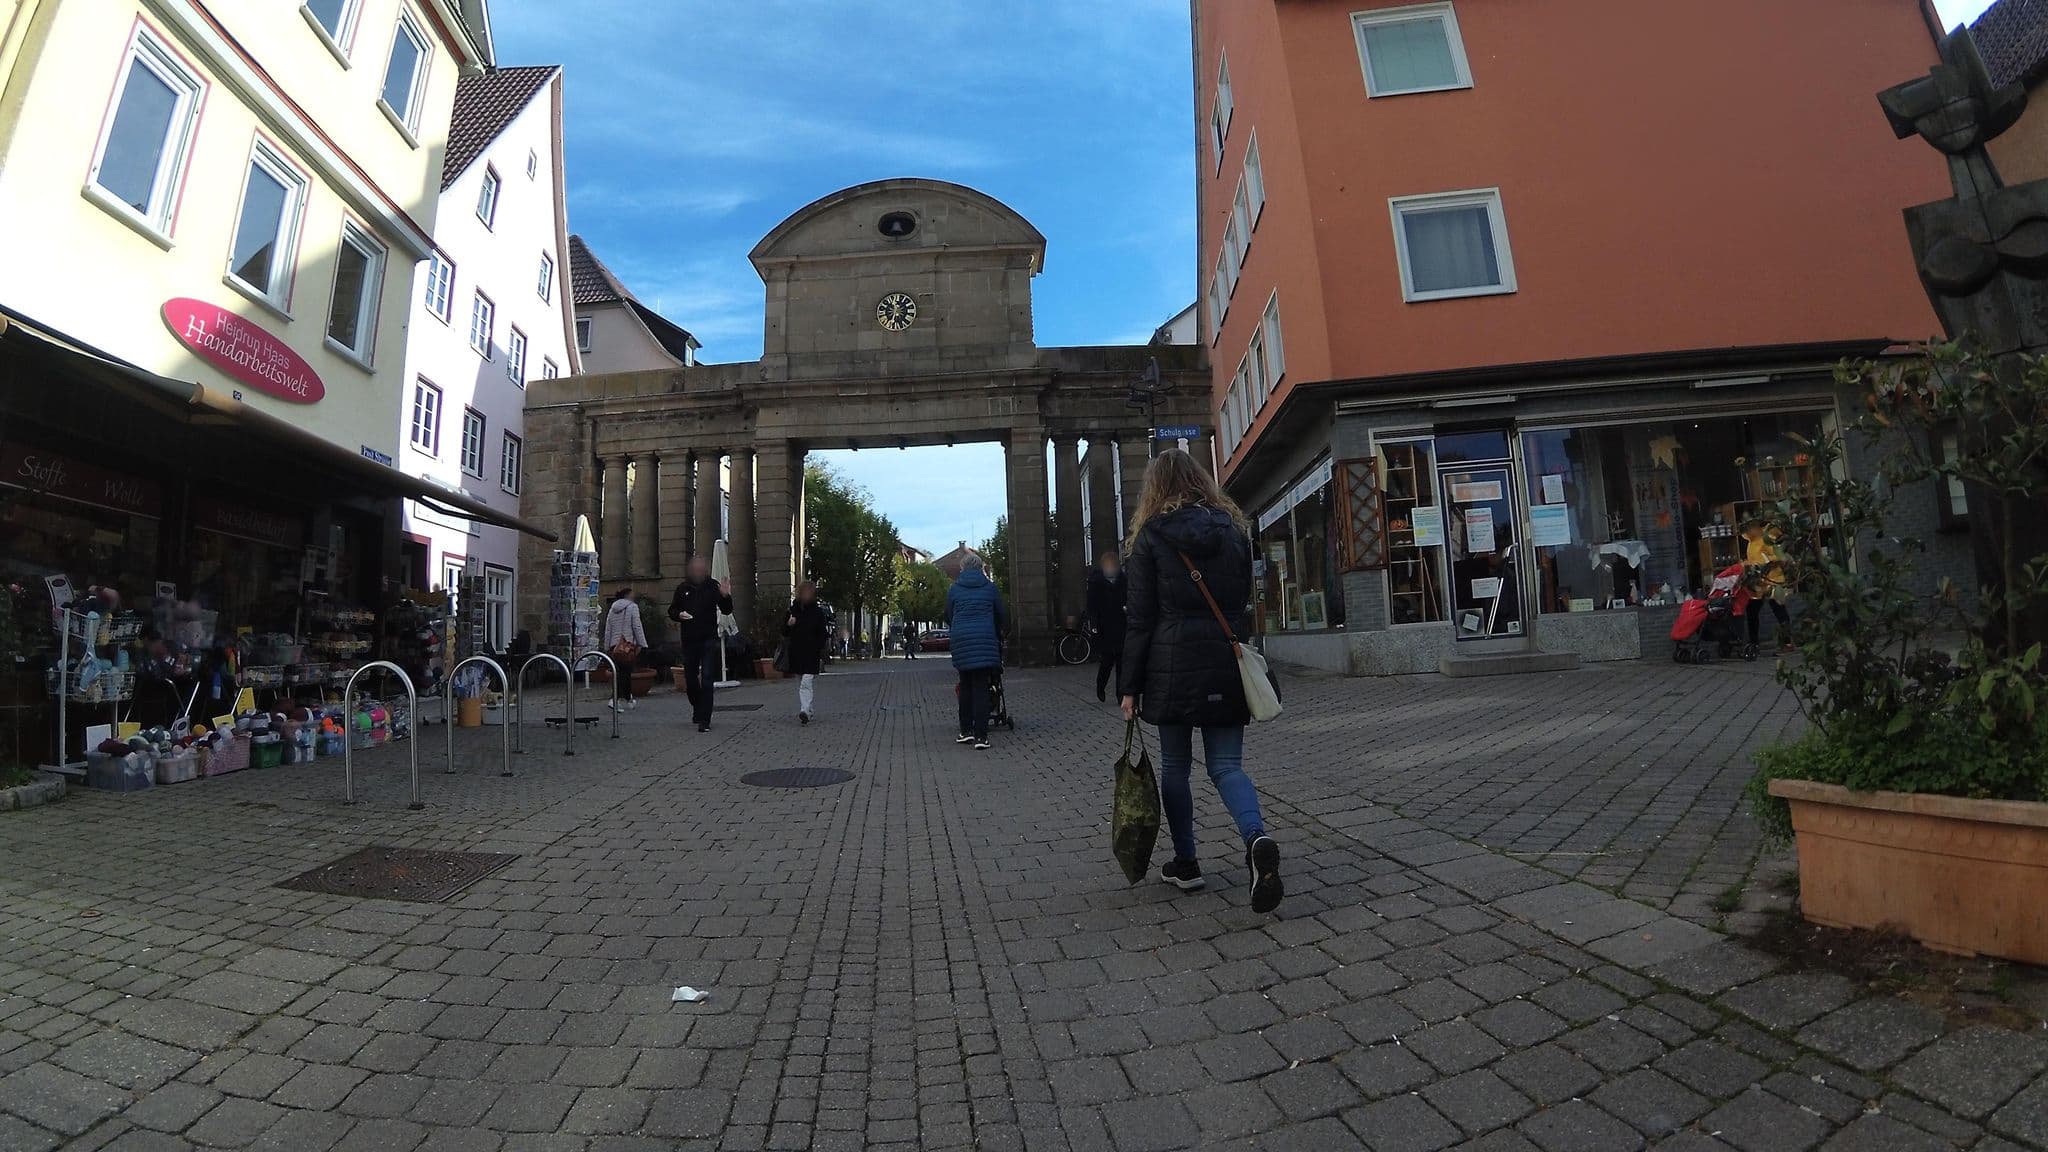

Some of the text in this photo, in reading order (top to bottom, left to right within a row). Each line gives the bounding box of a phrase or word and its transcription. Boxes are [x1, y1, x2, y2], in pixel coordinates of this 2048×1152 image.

[185, 314, 311, 397] Handarbeitswelt
[216, 312, 290, 369] Heidrun Haas
[17, 455, 67, 489] Stoffe
[104, 479, 145, 505] Wolle
[1669, 478, 1686, 569] Diakonie-Shop
